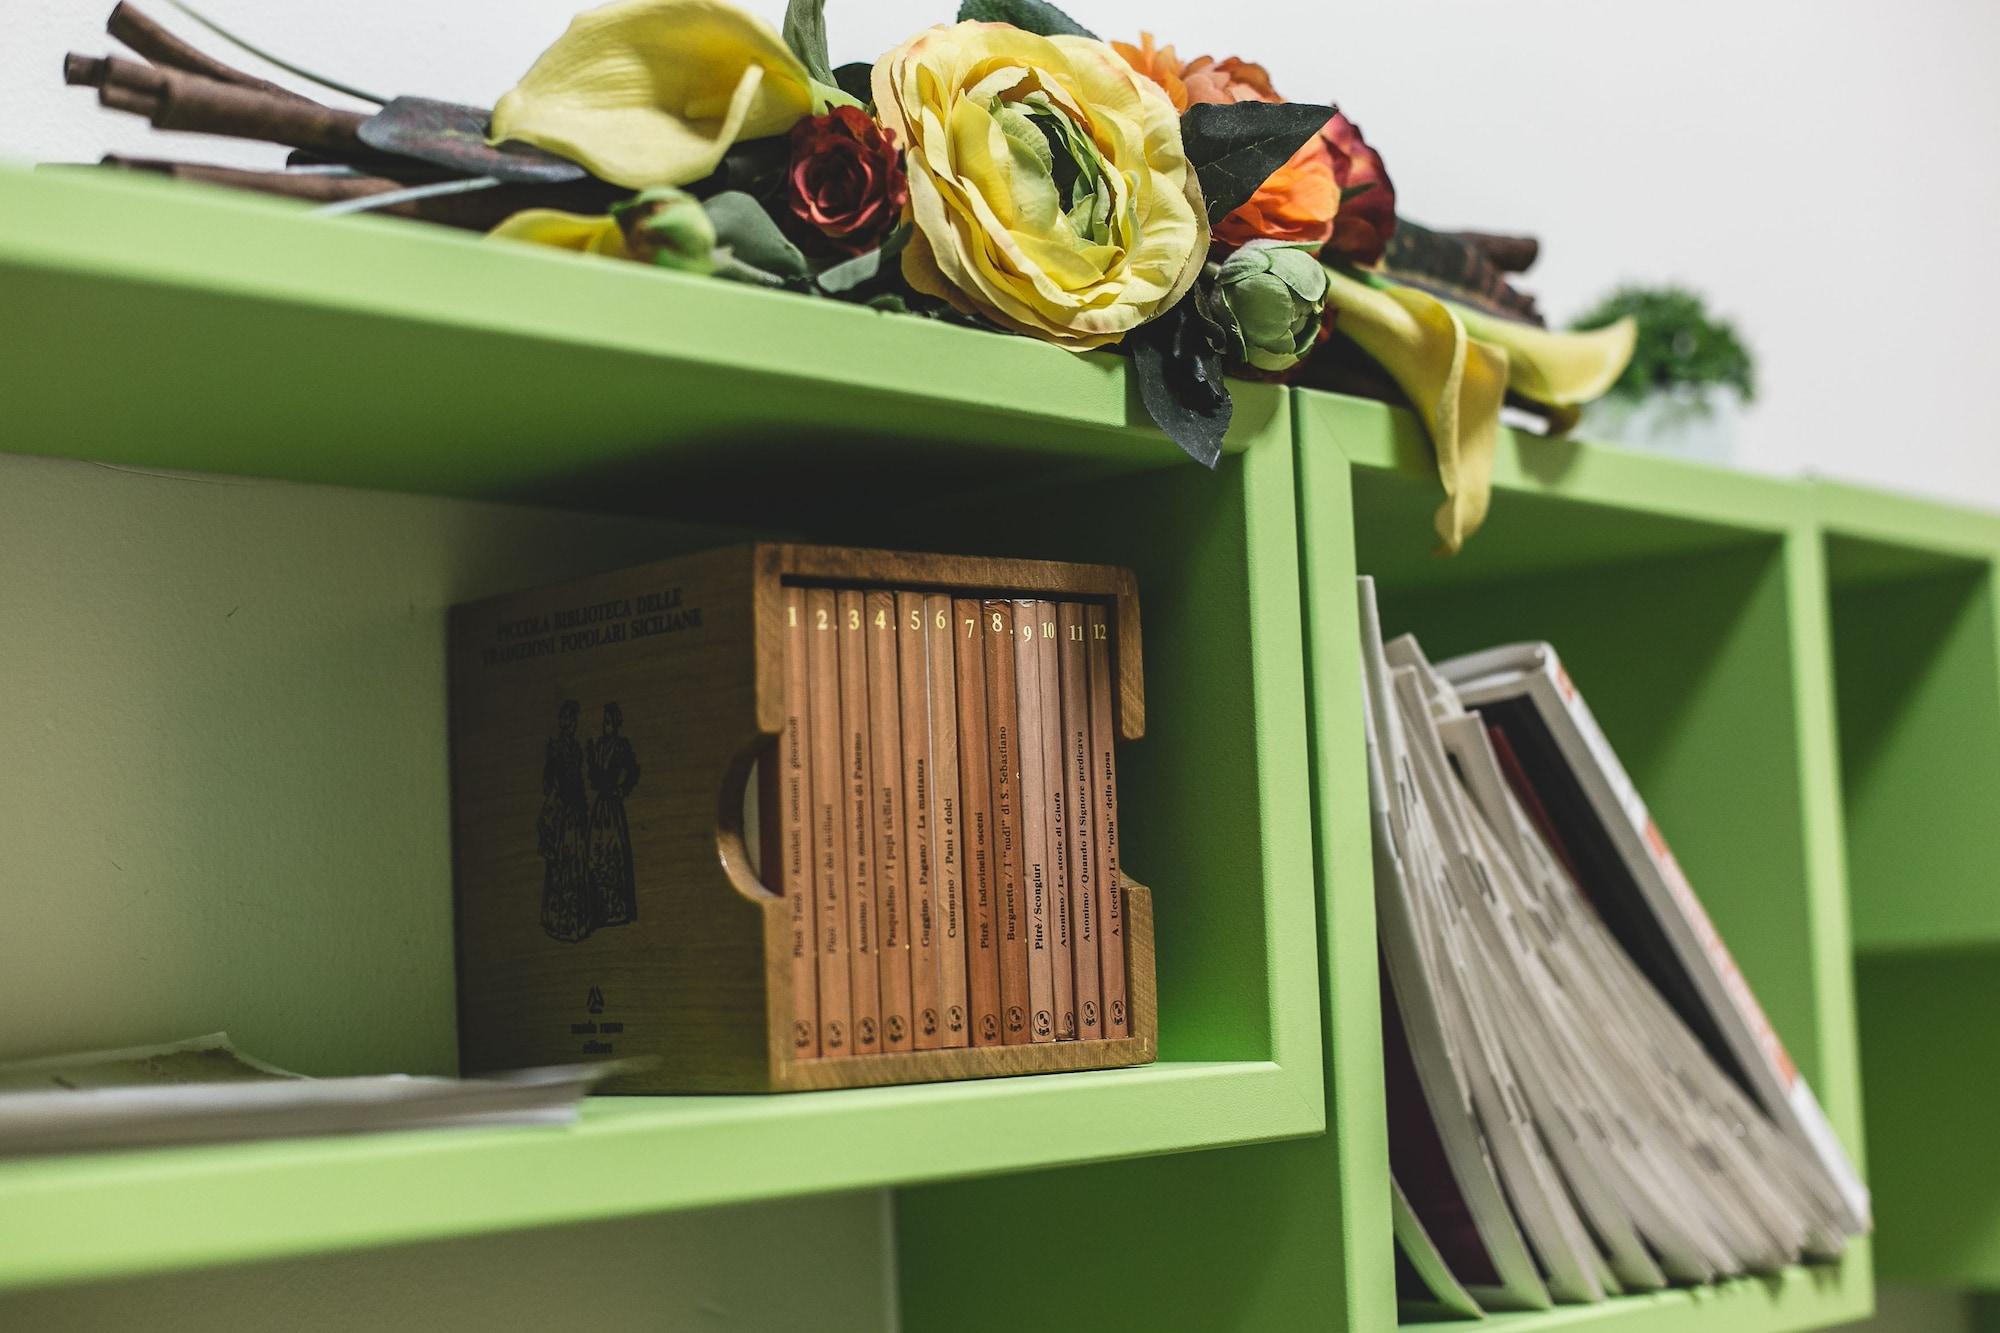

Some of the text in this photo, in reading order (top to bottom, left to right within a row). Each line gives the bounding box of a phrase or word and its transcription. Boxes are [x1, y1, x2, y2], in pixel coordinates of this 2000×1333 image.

[554, 599, 632, 630] BIBLIOTECA
[637, 587, 682, 614] DELLE
[787, 607, 797, 627] 1
[849, 609, 860, 630] 3
[910, 610, 921, 630] 5
[935, 610, 946, 629] 6
[560, 622, 626, 652] POPOLARI
[631, 608, 702, 639] SICILIANE
[965, 619, 975, 639] 7
[1023, 625, 1032, 642] 9
[1041, 622, 1055, 639] 10
[1070, 625, 1083, 641] 11
[1093, 624, 1106, 640] 12
[998, 726, 1009, 785] Sebastiano
[1076, 731, 1086, 782] predicava
[1104, 751, 1113, 781] sposa
[916, 758, 925, 810] mattanza
[1000, 789, 1009, 800] S.
[1105, 784, 1113, 809] della
[943, 798, 953, 825] dolci
[1001, 804, 1009, 815] di
[1079, 785, 1087, 826] Signore
[917, 815, 926, 829] La
[974, 812, 984, 846] osceni
[1055, 827, 1062, 838] di
[918, 844, 928, 886] Pagano
[944, 839, 954, 865] Pani
[976, 850, 987, 908] Indovinelli
[886, 885, 899, 947] Pasqualino
[947, 879, 956, 939] Cusumano
[1006, 883, 1016, 941] Burgaretta
[920, 899, 930, 947] Guggino
[1111, 923, 1120, 937] A.
